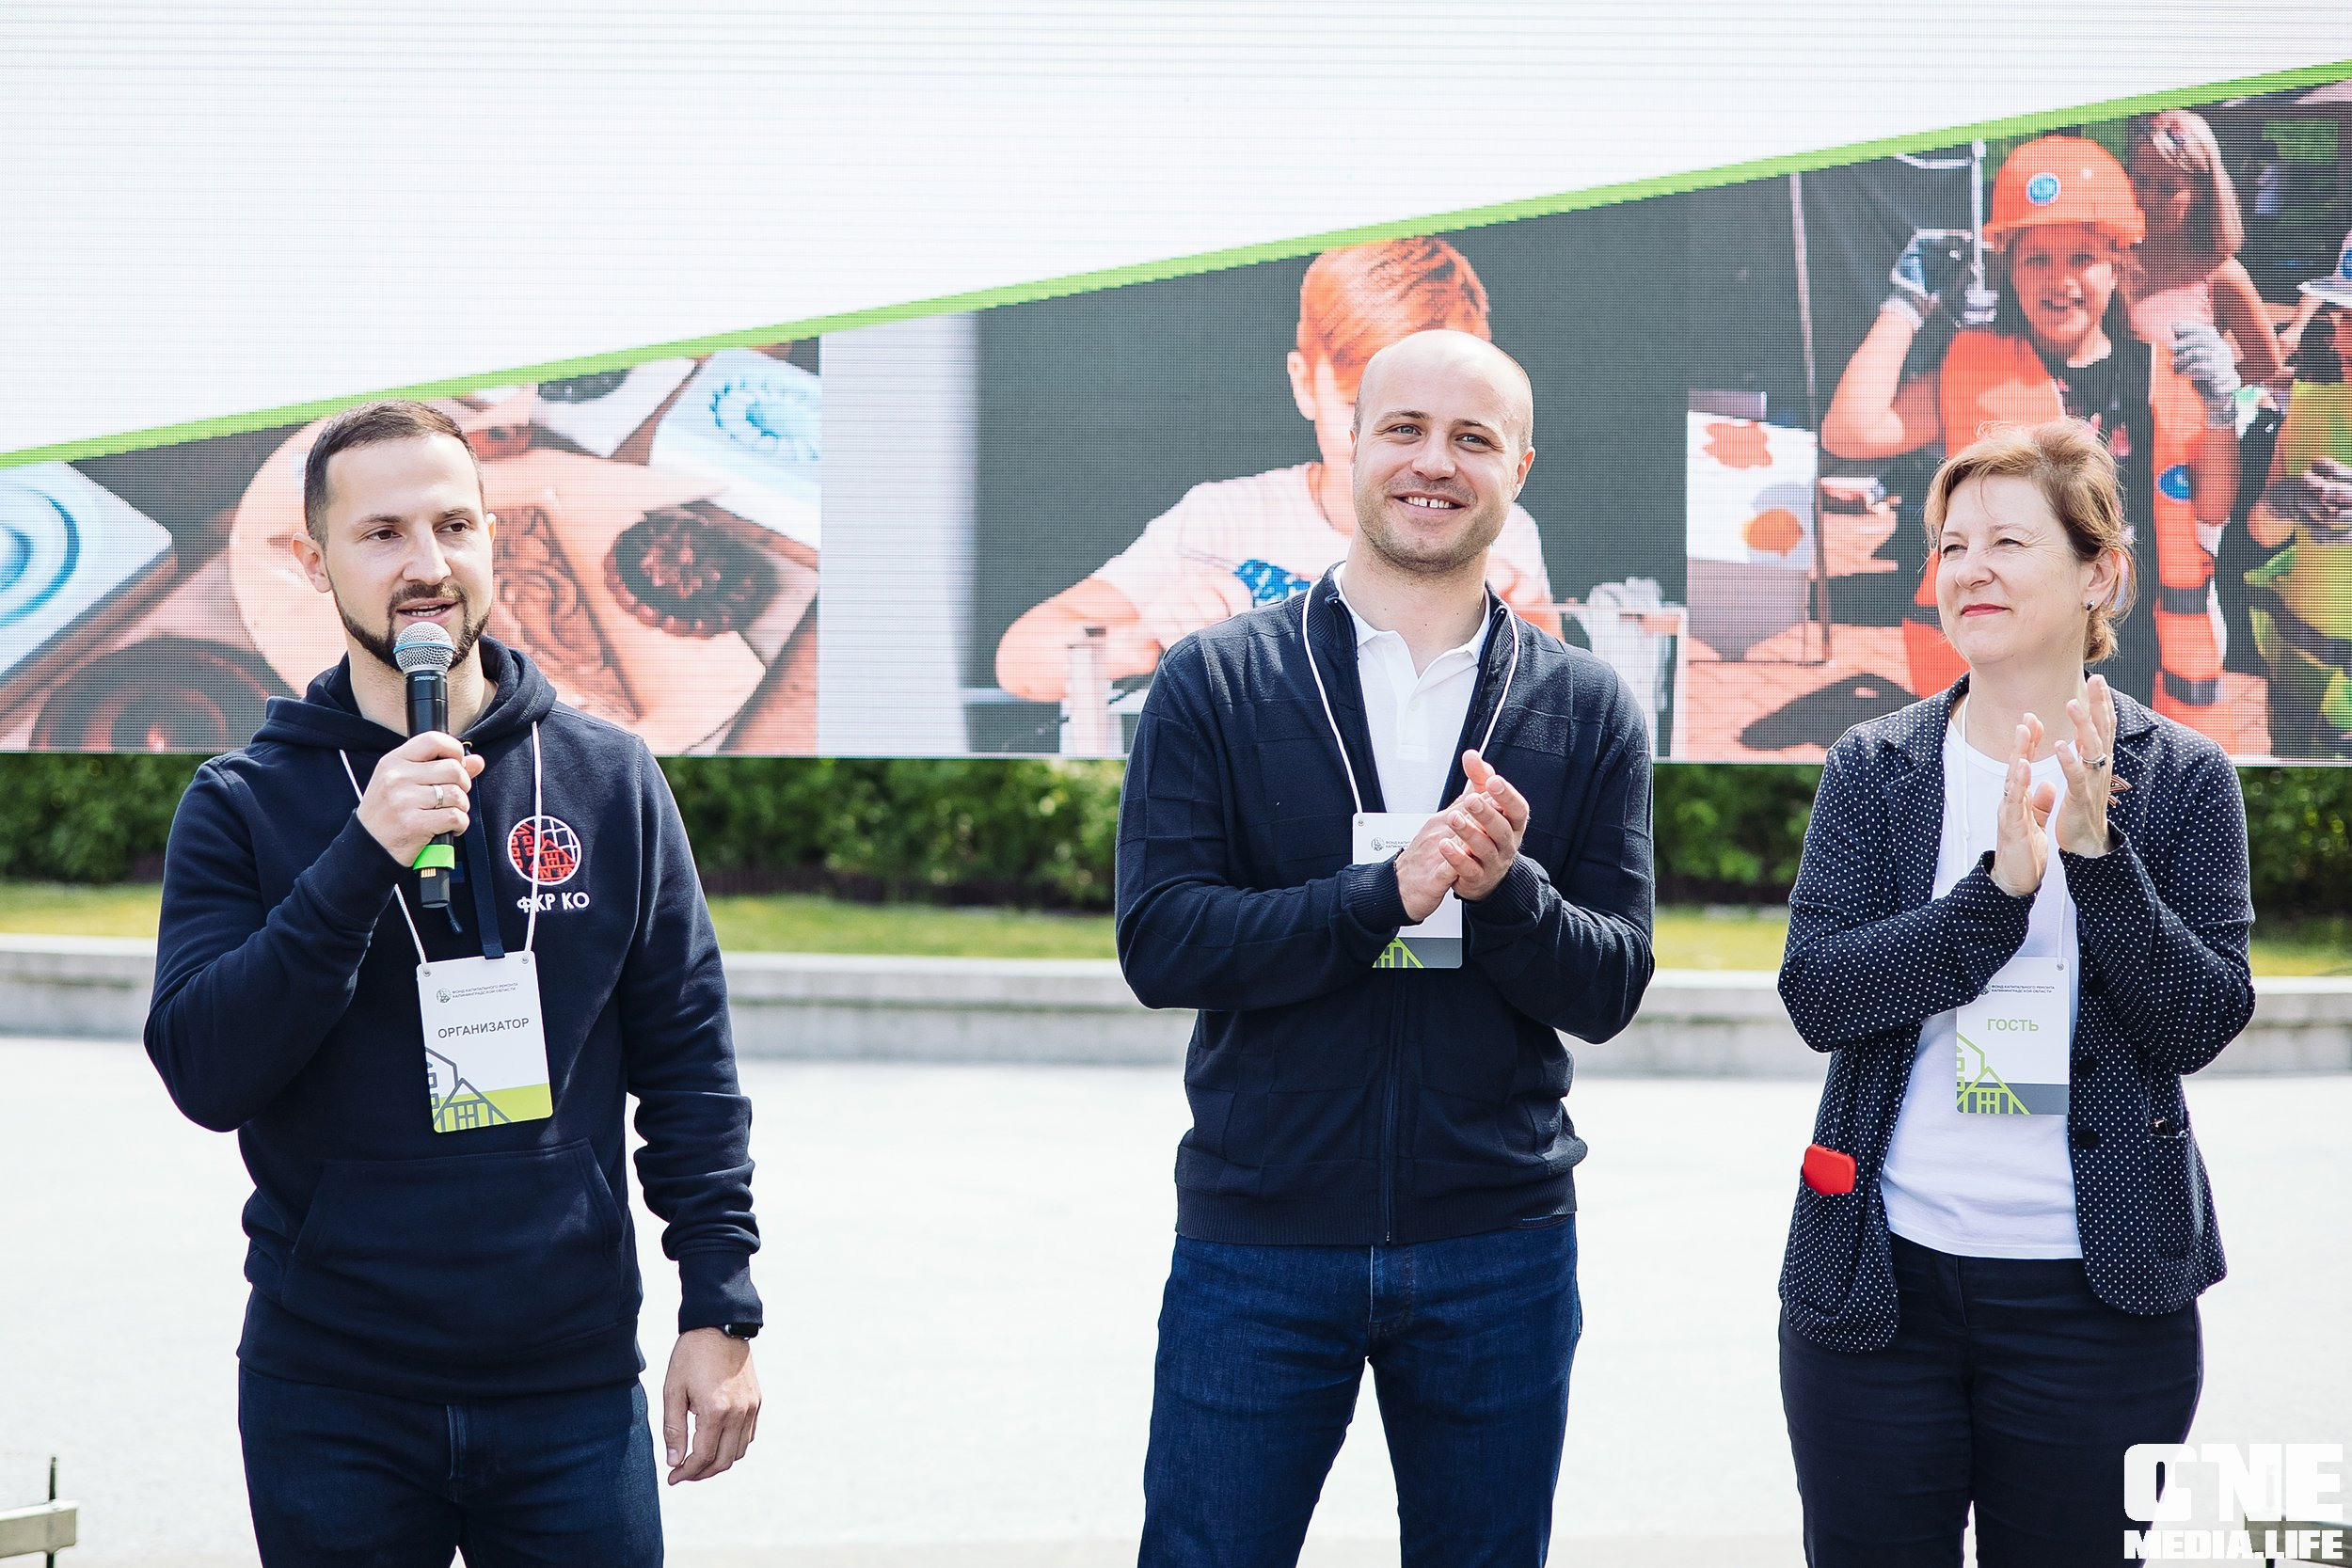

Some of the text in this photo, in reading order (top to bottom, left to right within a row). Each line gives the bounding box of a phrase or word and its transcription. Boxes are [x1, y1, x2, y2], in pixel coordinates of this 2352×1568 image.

[561, 892, 590, 911] КО
[437, 1018, 530, 1039] ОРГАНИЗАТОР
[1987, 1018, 2040, 1032] ГОСТЬ
